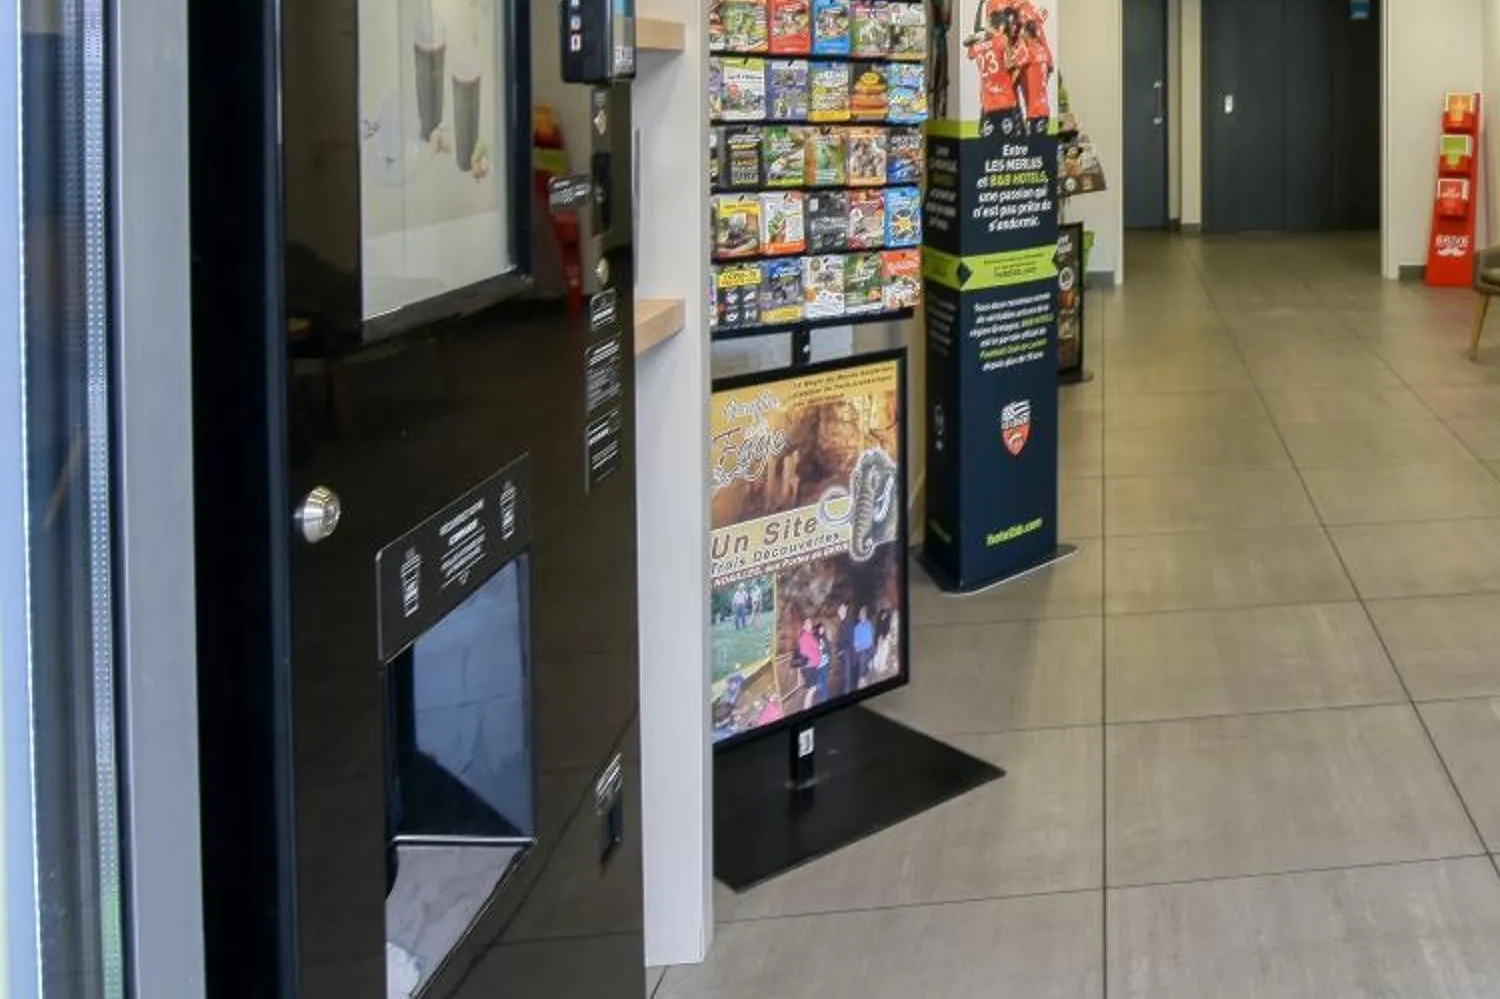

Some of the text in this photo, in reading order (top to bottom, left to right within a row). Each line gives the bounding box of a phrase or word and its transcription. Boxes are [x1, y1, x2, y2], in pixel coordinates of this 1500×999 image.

[1003, 144, 1029, 156] Entre
[985, 160, 1005, 173] LES
[712, 533, 749, 560] Un
[763, 515, 818, 546] Site
